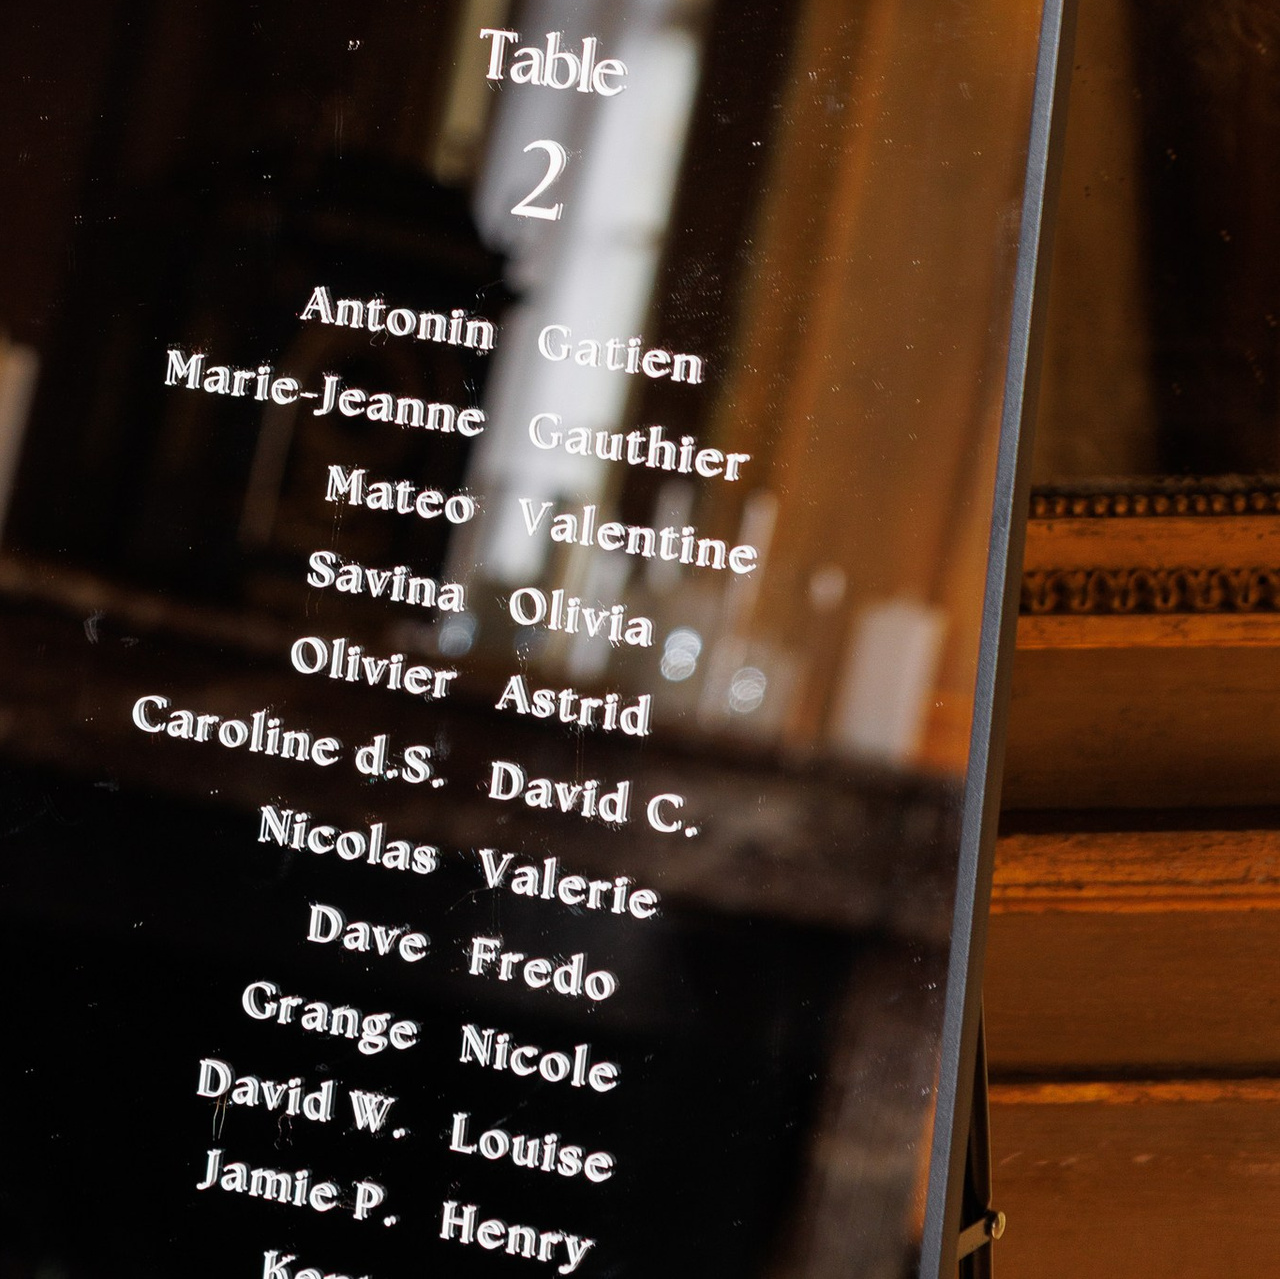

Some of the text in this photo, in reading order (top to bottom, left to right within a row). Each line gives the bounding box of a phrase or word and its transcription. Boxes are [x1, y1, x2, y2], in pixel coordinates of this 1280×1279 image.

[480, 29, 632, 99] Table
[511, 140, 566, 220] 2
[300, 286, 493, 349] Antonin
[538, 322, 701, 388] Gatien
[165, 350, 485, 436] Marie-Jeanne
[529, 410, 749, 480] Gauthier
[325, 465, 476, 523] Mateo
[516, 497, 757, 573] Valentine
[307, 551, 464, 612] Savina
[510, 588, 652, 646] Olivia
[291, 637, 457, 698] Olivier
[495, 675, 651, 736] Astrid
[133, 696, 444, 788] Caroline d.S.
[489, 761, 697, 837] David C.
[258, 806, 436, 874] Nicolas
[479, 849, 657, 918] Valerie
[307, 904, 426, 962] Dave
[469, 937, 615, 1000] Fredo
[242, 982, 417, 1054] Grange
[460, 1025, 617, 1092] Nicole
[197, 1059, 405, 1138] David W.
[450, 1113, 613, 1182] Louise
[197, 1149, 396, 1226] Jamie P.
[440, 1201, 593, 1274] Henry
